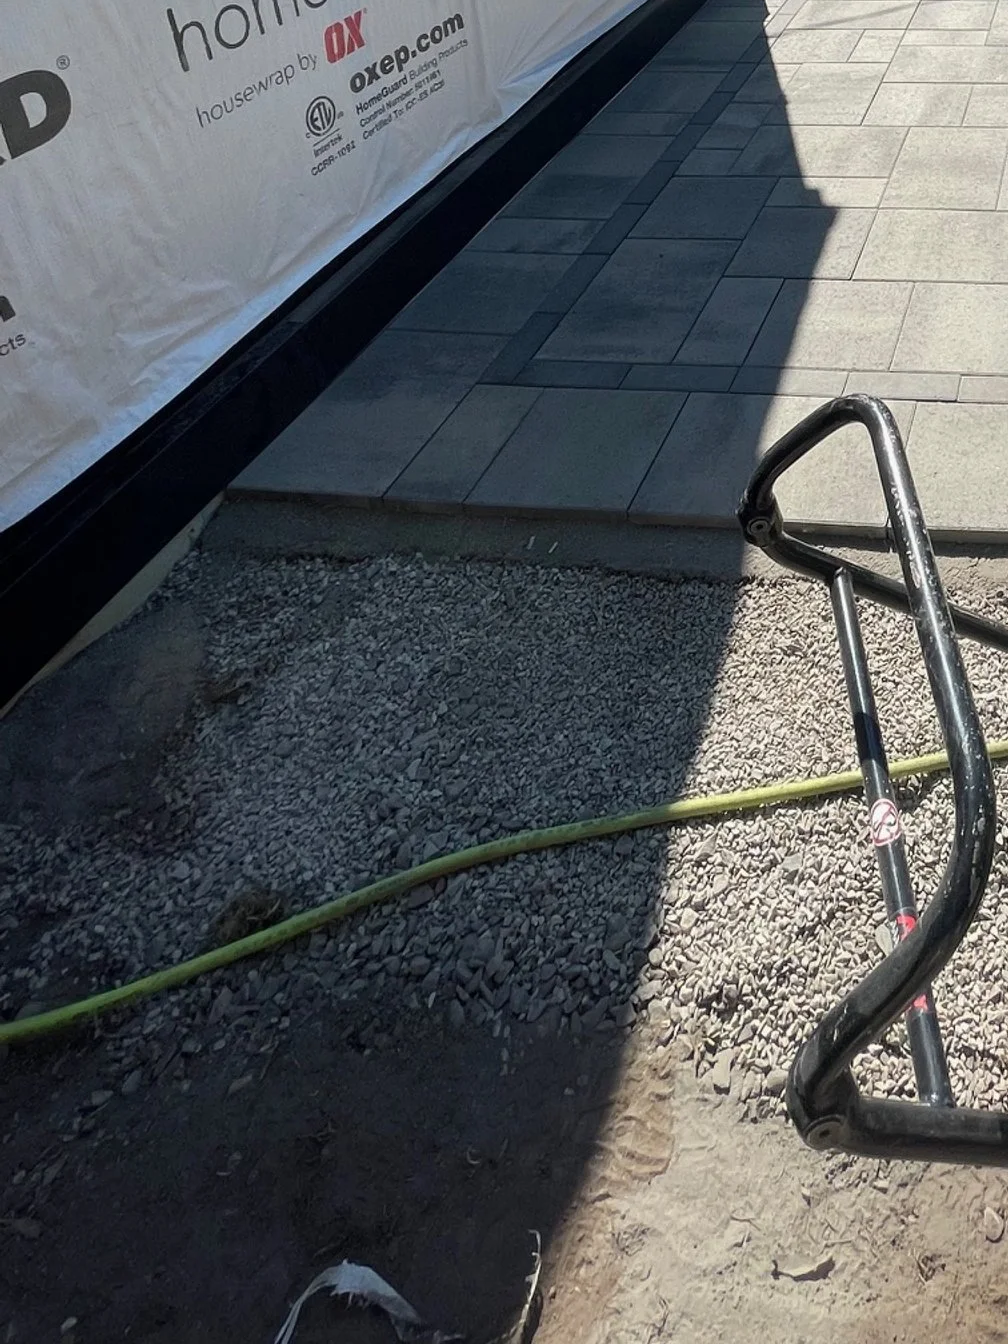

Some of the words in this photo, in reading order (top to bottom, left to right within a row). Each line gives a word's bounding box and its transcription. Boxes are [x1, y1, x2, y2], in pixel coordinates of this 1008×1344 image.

[196, 64, 296, 128] housewrap
[298, 52, 318, 72] by
[324, 10, 365, 64] OX
[350, 13, 465, 93] oxep.com
